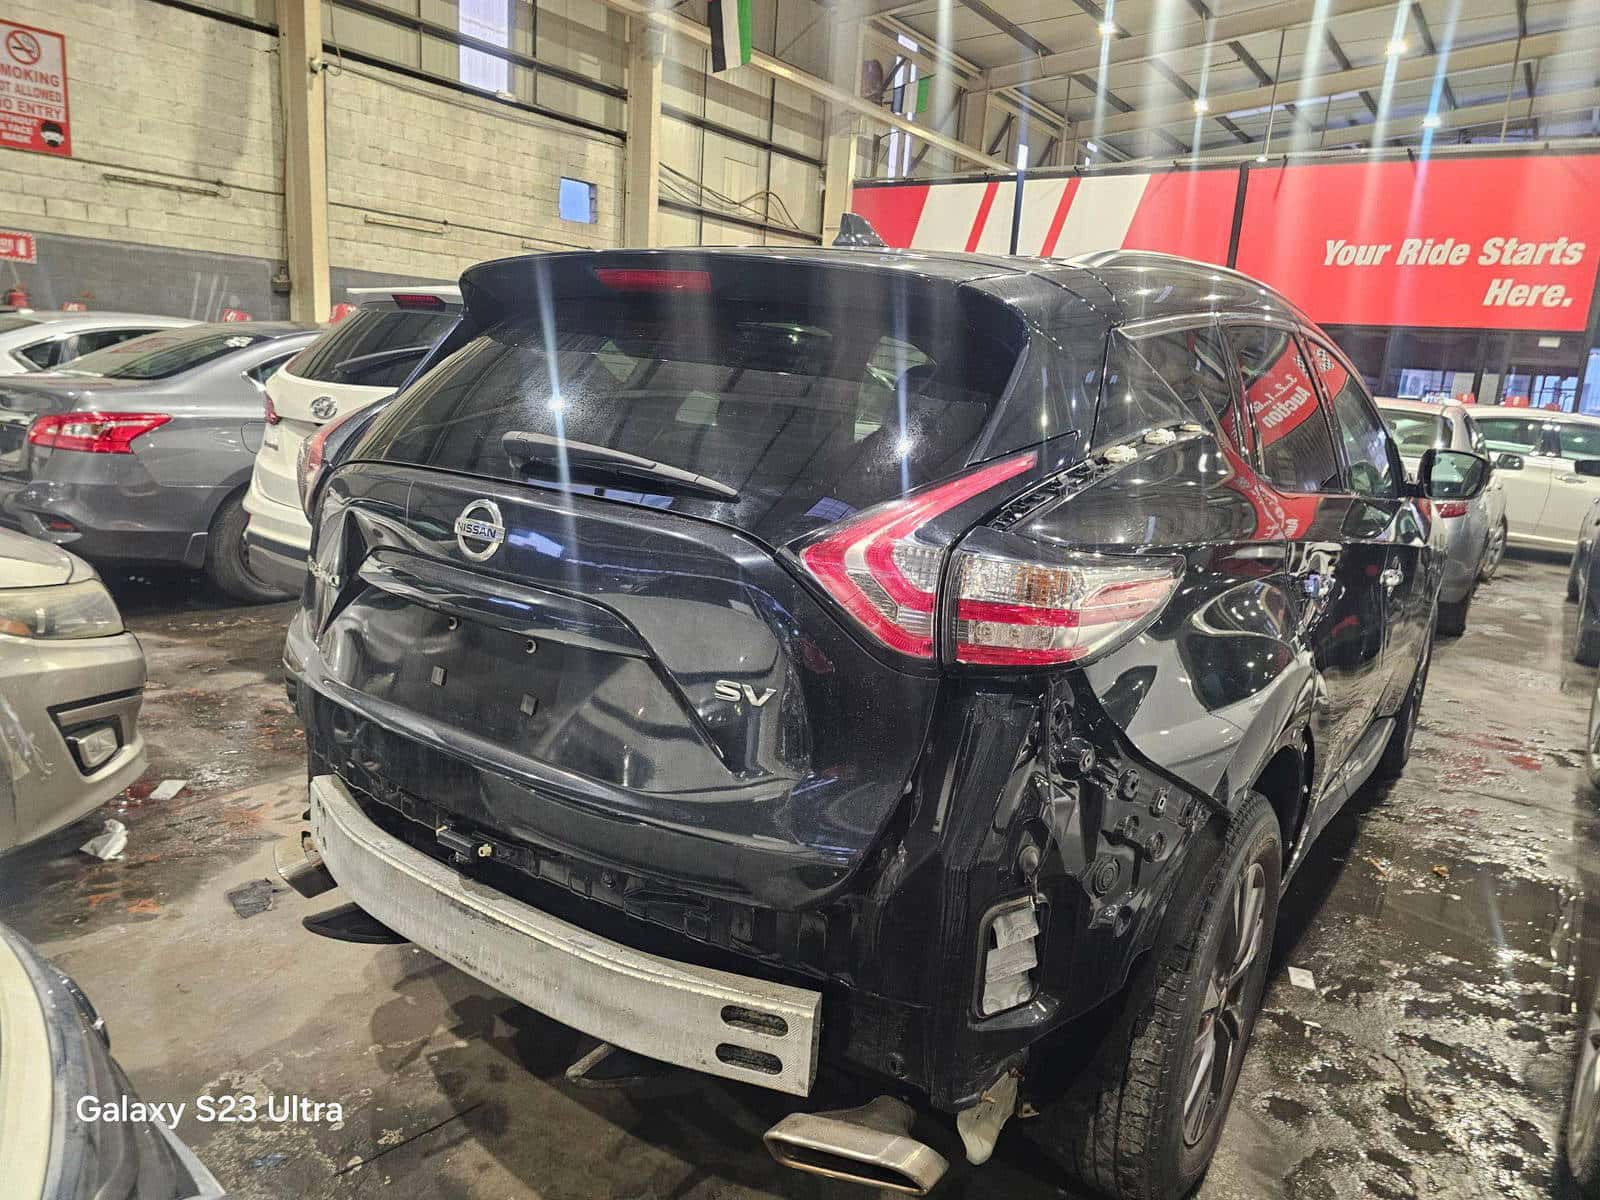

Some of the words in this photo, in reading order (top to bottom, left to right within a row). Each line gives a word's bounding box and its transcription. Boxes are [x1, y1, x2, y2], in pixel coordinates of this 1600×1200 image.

[0, 63, 60, 87] MOKING
[15, 83, 62, 103] ALLOWED
[0, 98, 12, 110] O
[17, 101, 61, 120] ENTRY
[1323, 239, 1391, 266] Your
[1396, 238, 1471, 266] Ride
[1478, 237, 1586, 266] Starts
[1482, 278, 1573, 307] Here.
[457, 522, 497, 538] NISSAN
[714, 680, 777, 707] SV
